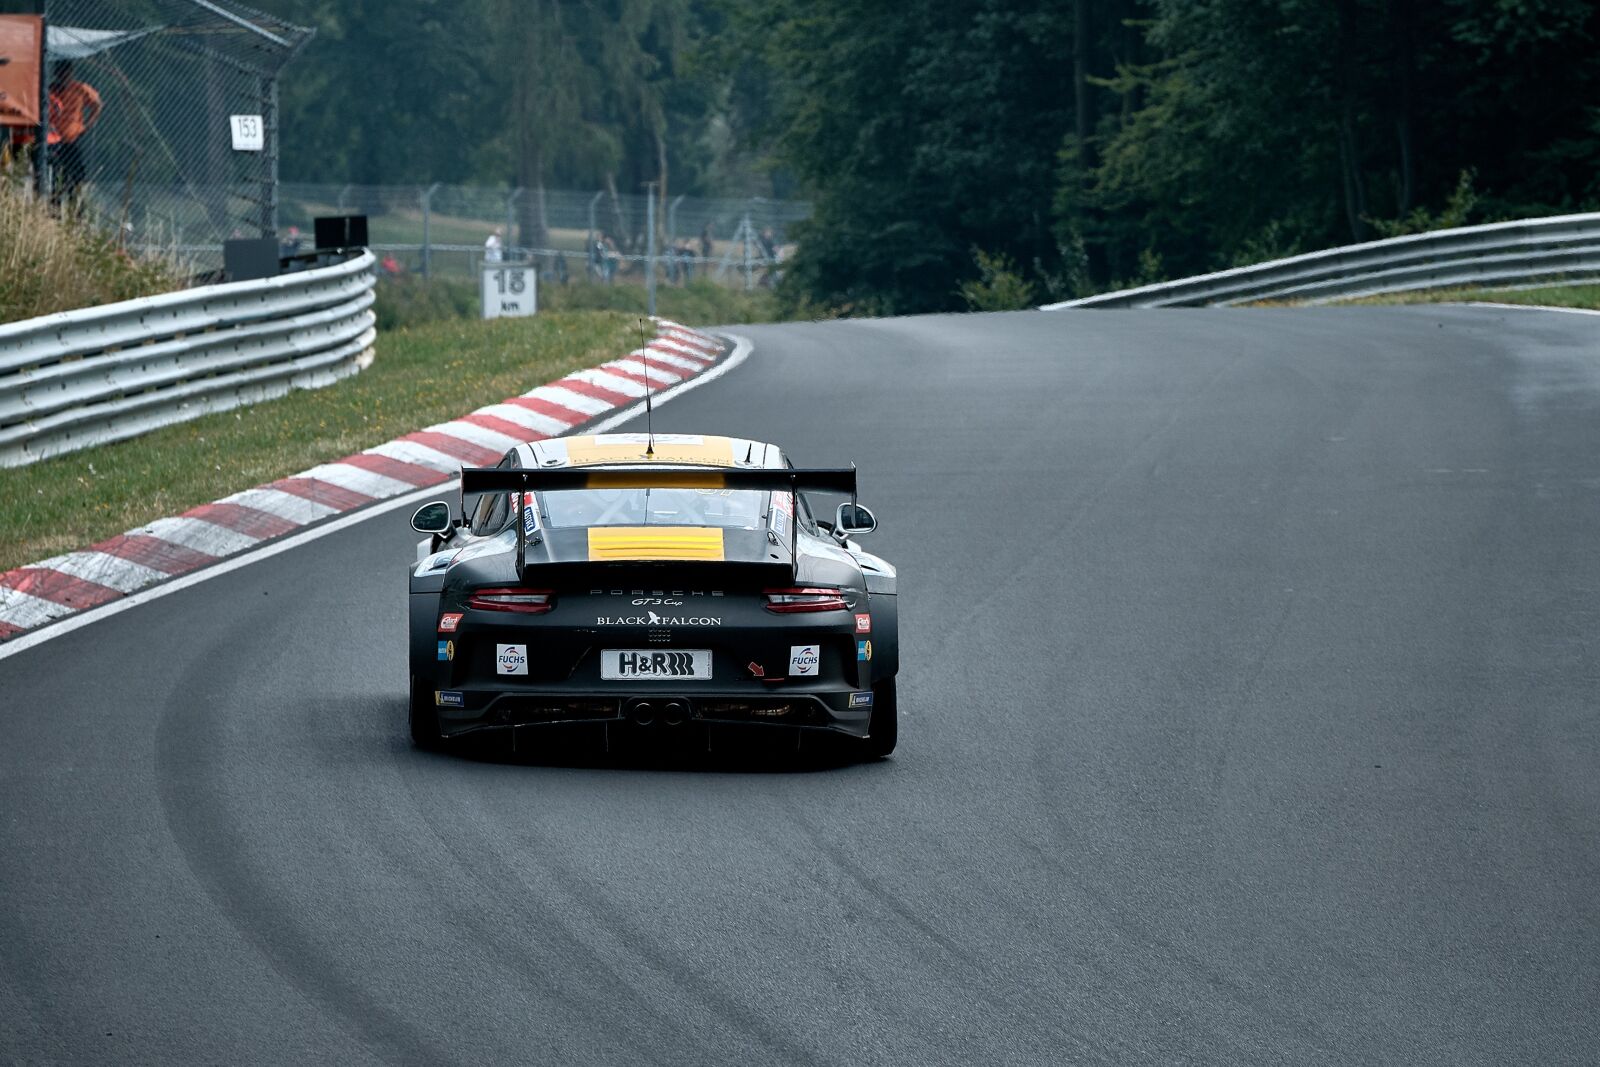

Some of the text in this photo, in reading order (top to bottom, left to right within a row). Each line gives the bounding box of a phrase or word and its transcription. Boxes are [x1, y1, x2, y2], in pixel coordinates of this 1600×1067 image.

[238, 117, 257, 138] 153
[501, 300, 519, 311] km
[590, 589, 724, 597] PORSCHE
[663, 598, 683, 606] Cup
[597, 616, 722, 626] BLACK FALCON
[498, 655, 526, 664] FUCHS
[791, 656, 818, 665] FUCHS
